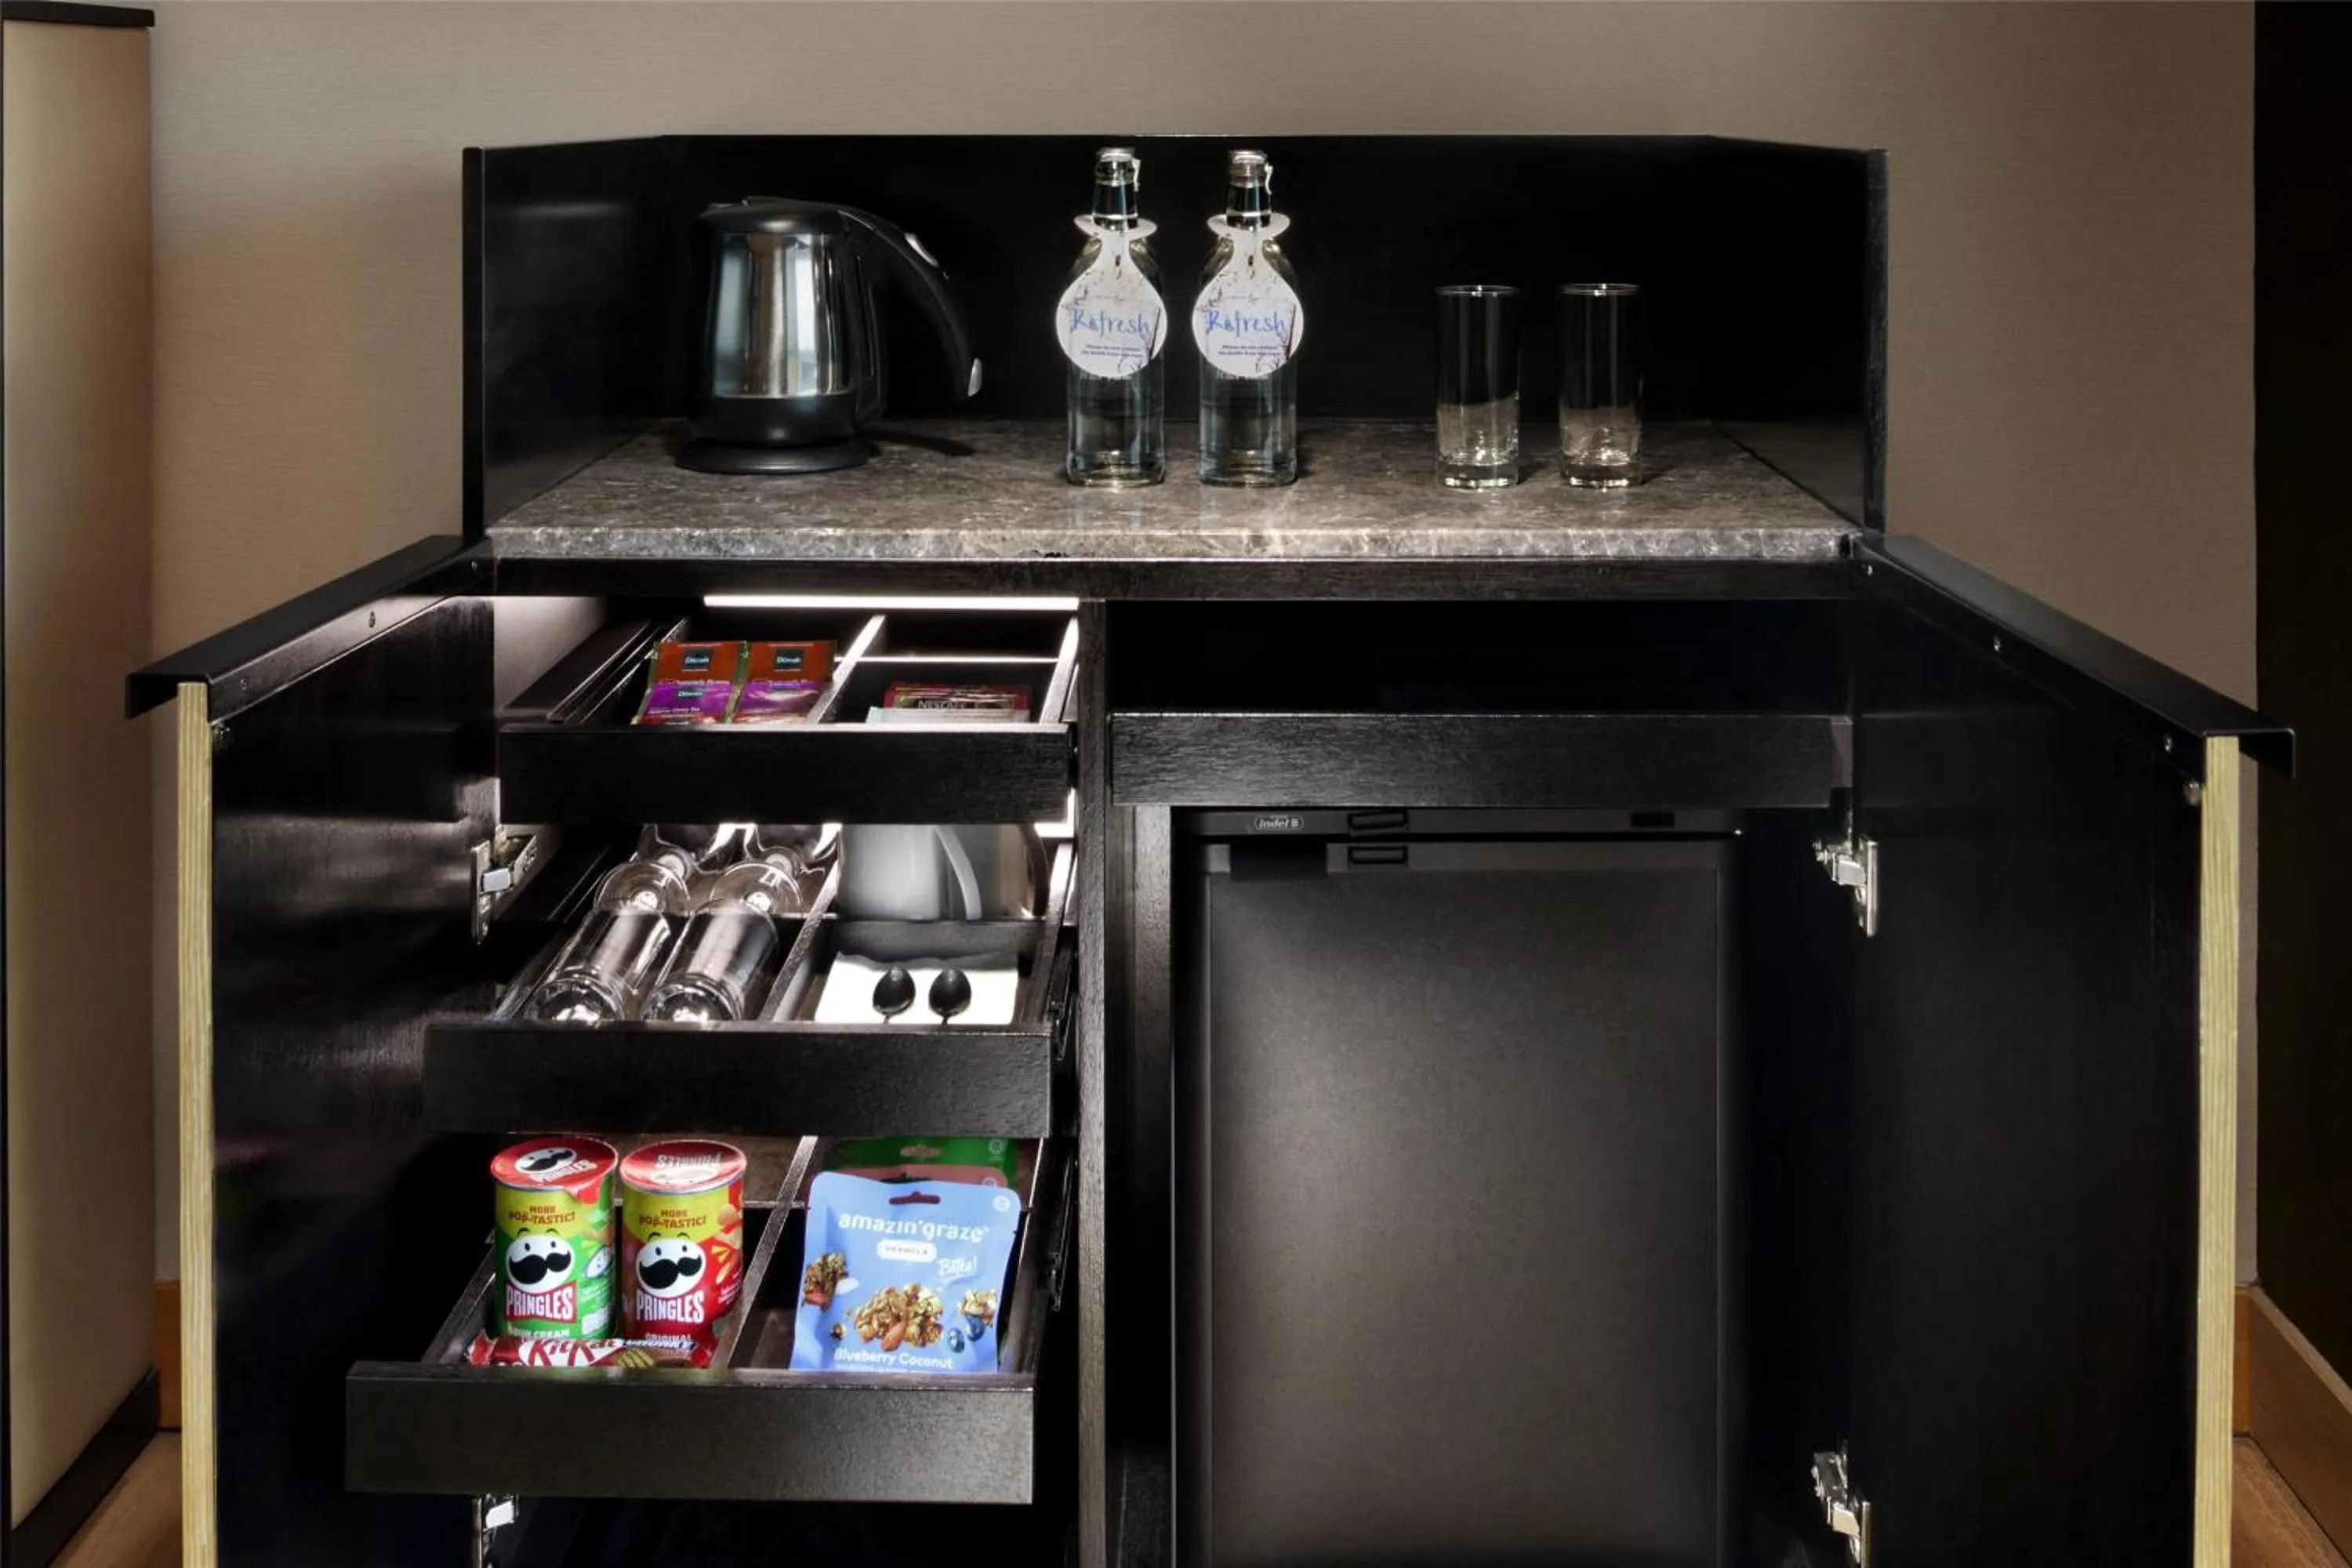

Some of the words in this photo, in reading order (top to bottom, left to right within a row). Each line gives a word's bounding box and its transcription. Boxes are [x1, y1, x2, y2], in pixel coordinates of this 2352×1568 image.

[530, 1205, 556, 1214] MORE
[661, 1208, 688, 1217] MORE
[506, 1283, 575, 1319] PRINGLES
[637, 1290, 705, 1323] PRINGLES
[834, 1348, 895, 1365] Blueberry
[900, 1354, 953, 1369] Coconut
